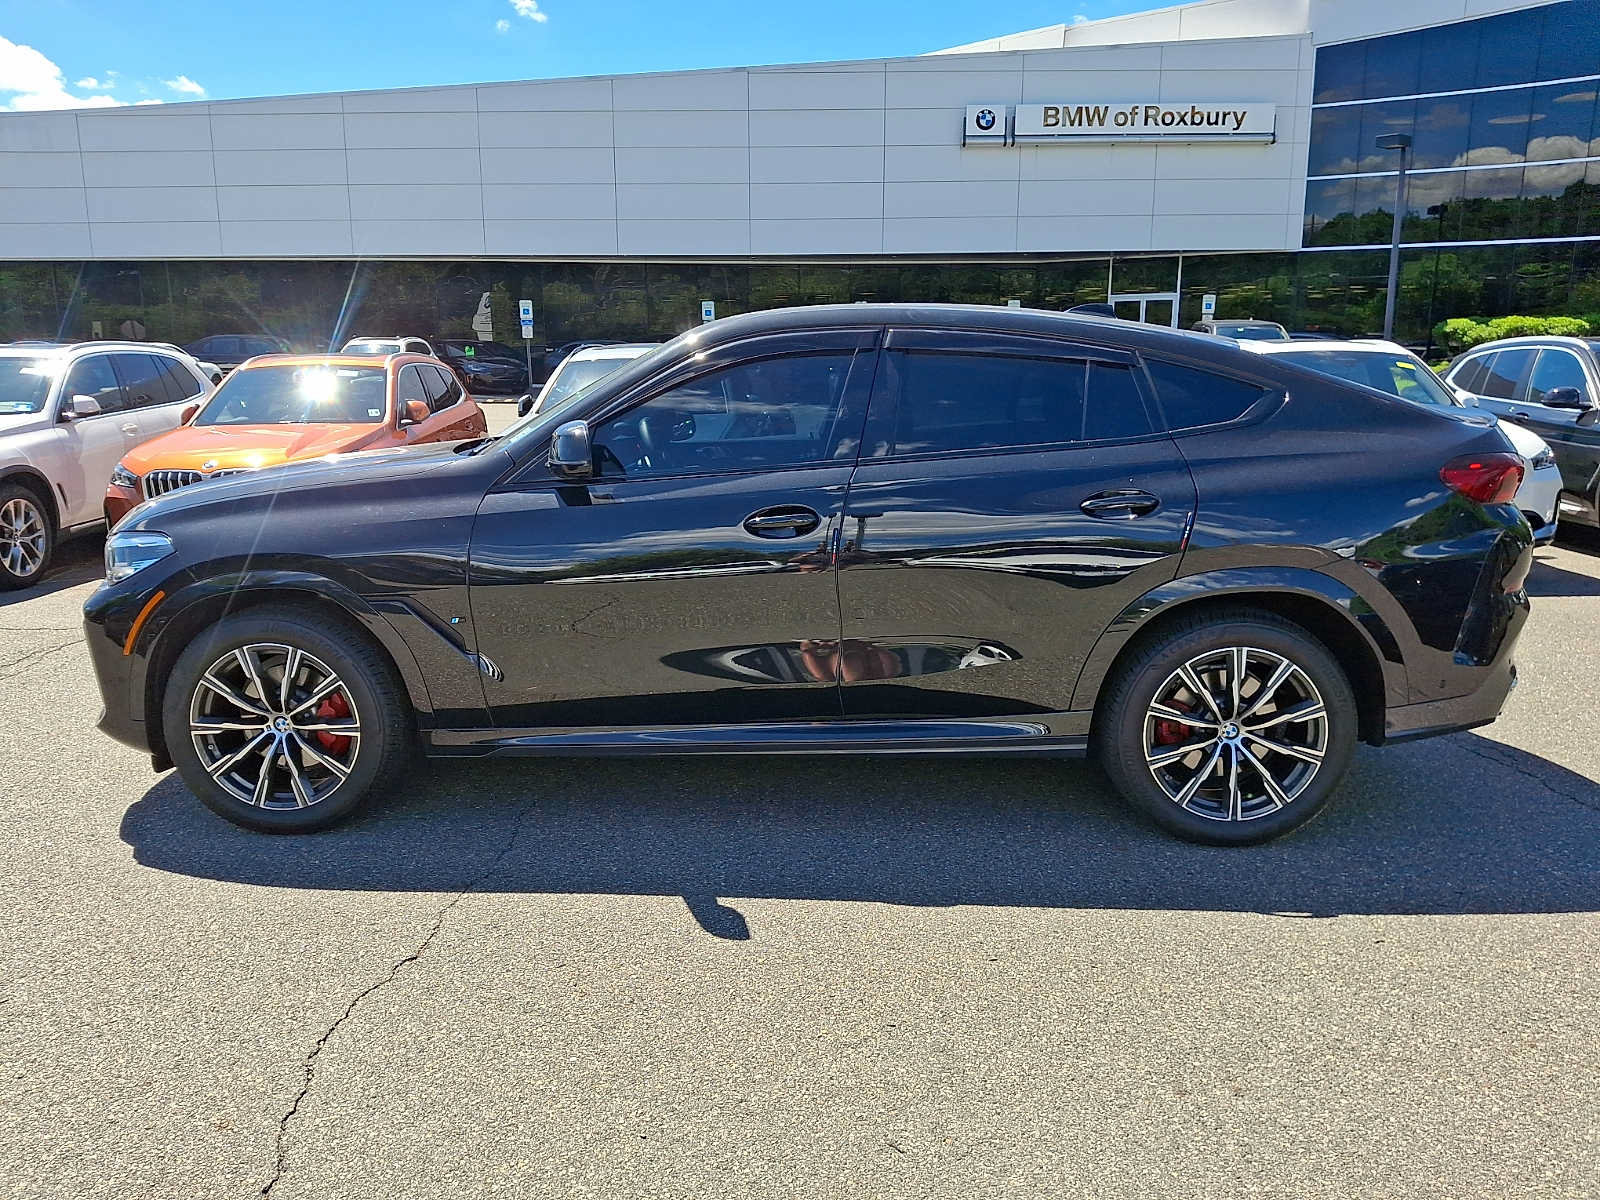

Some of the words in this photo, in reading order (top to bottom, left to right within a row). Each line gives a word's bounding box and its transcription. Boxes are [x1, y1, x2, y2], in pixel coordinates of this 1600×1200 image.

[1042, 105, 1109, 127] BMW
[1113, 104, 1139, 126] of
[1143, 105, 1247, 130] Roxbury
